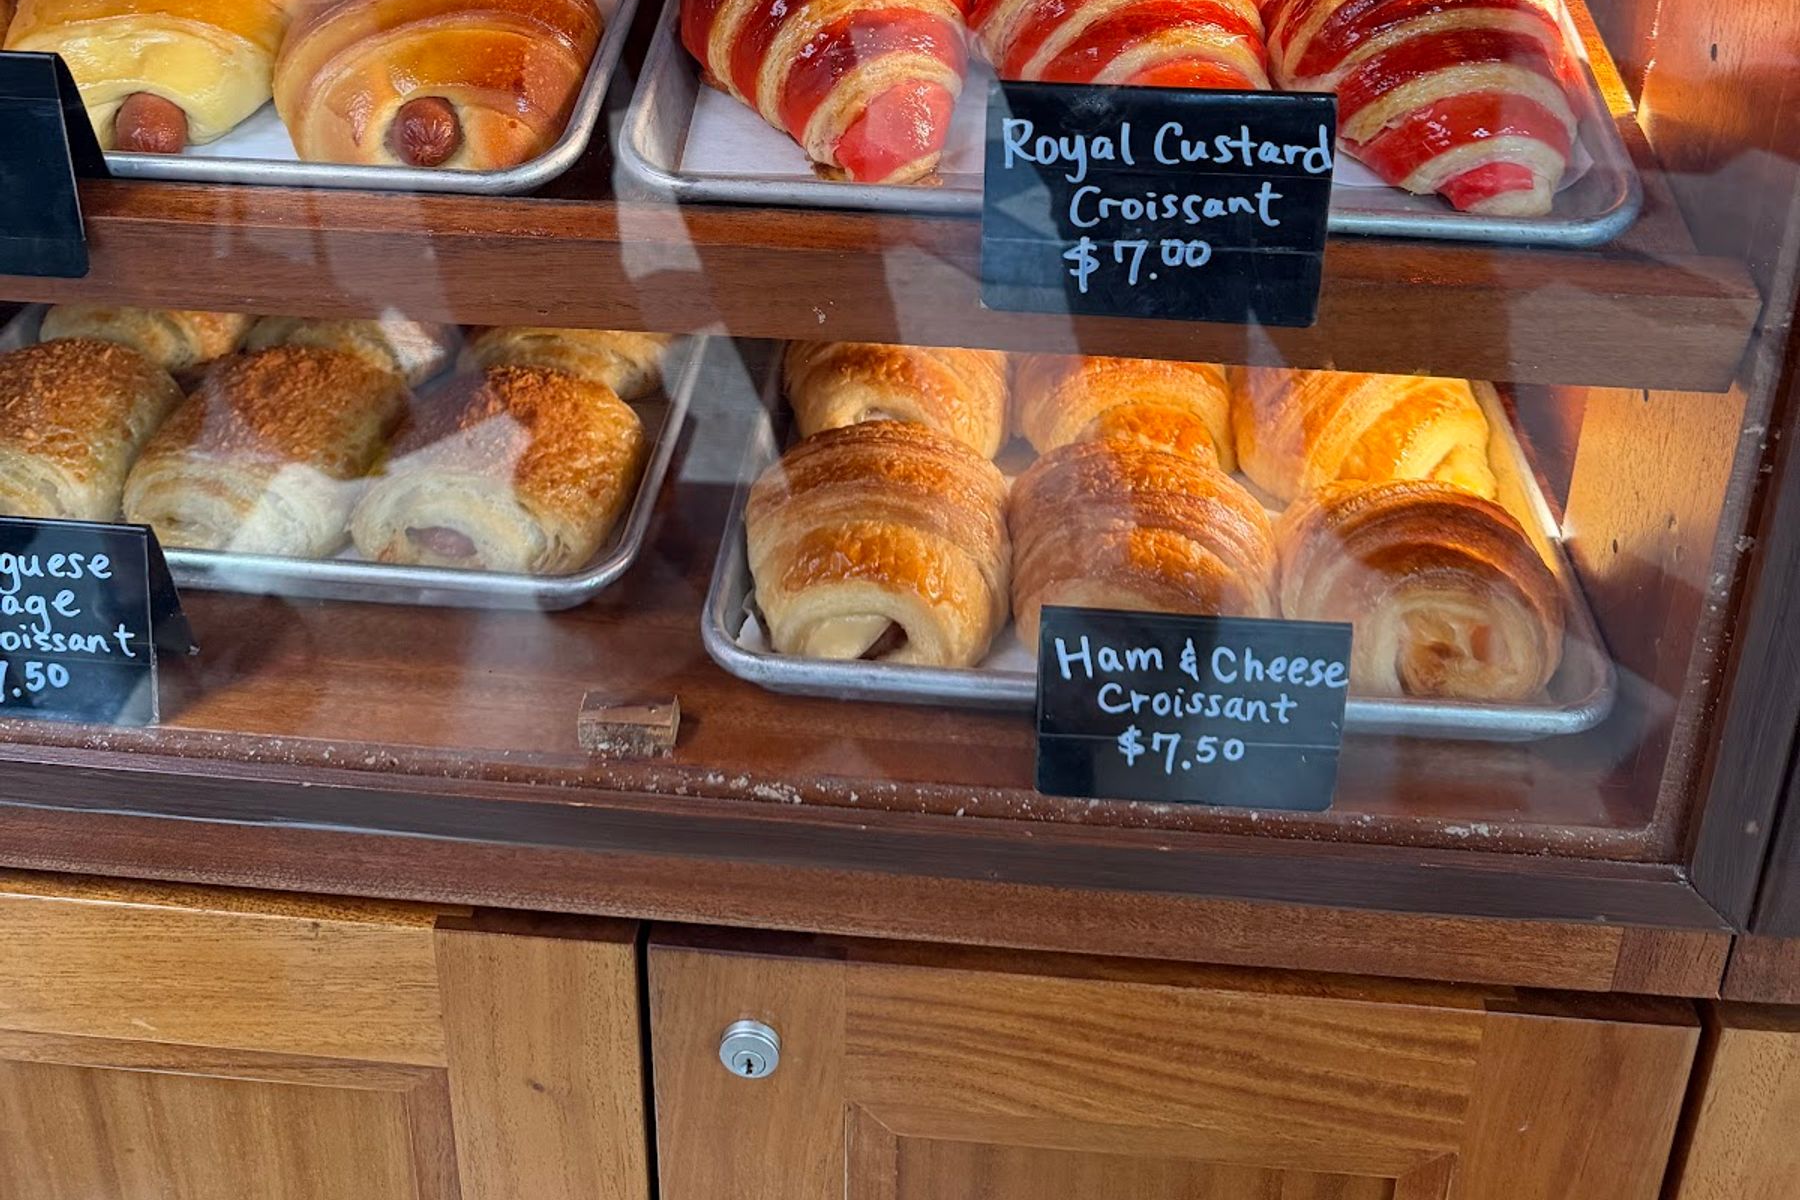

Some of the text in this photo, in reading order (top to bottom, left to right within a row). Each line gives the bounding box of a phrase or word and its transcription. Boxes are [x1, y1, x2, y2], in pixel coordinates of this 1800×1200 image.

[1002, 118, 1335, 183] Royal Custard
[1069, 182, 1283, 228] Croissant
[1055, 635, 1348, 688] Ham & Cheese
[1097, 682, 1298, 724] Croissant
[1117, 724, 1246, 775] $7.50
